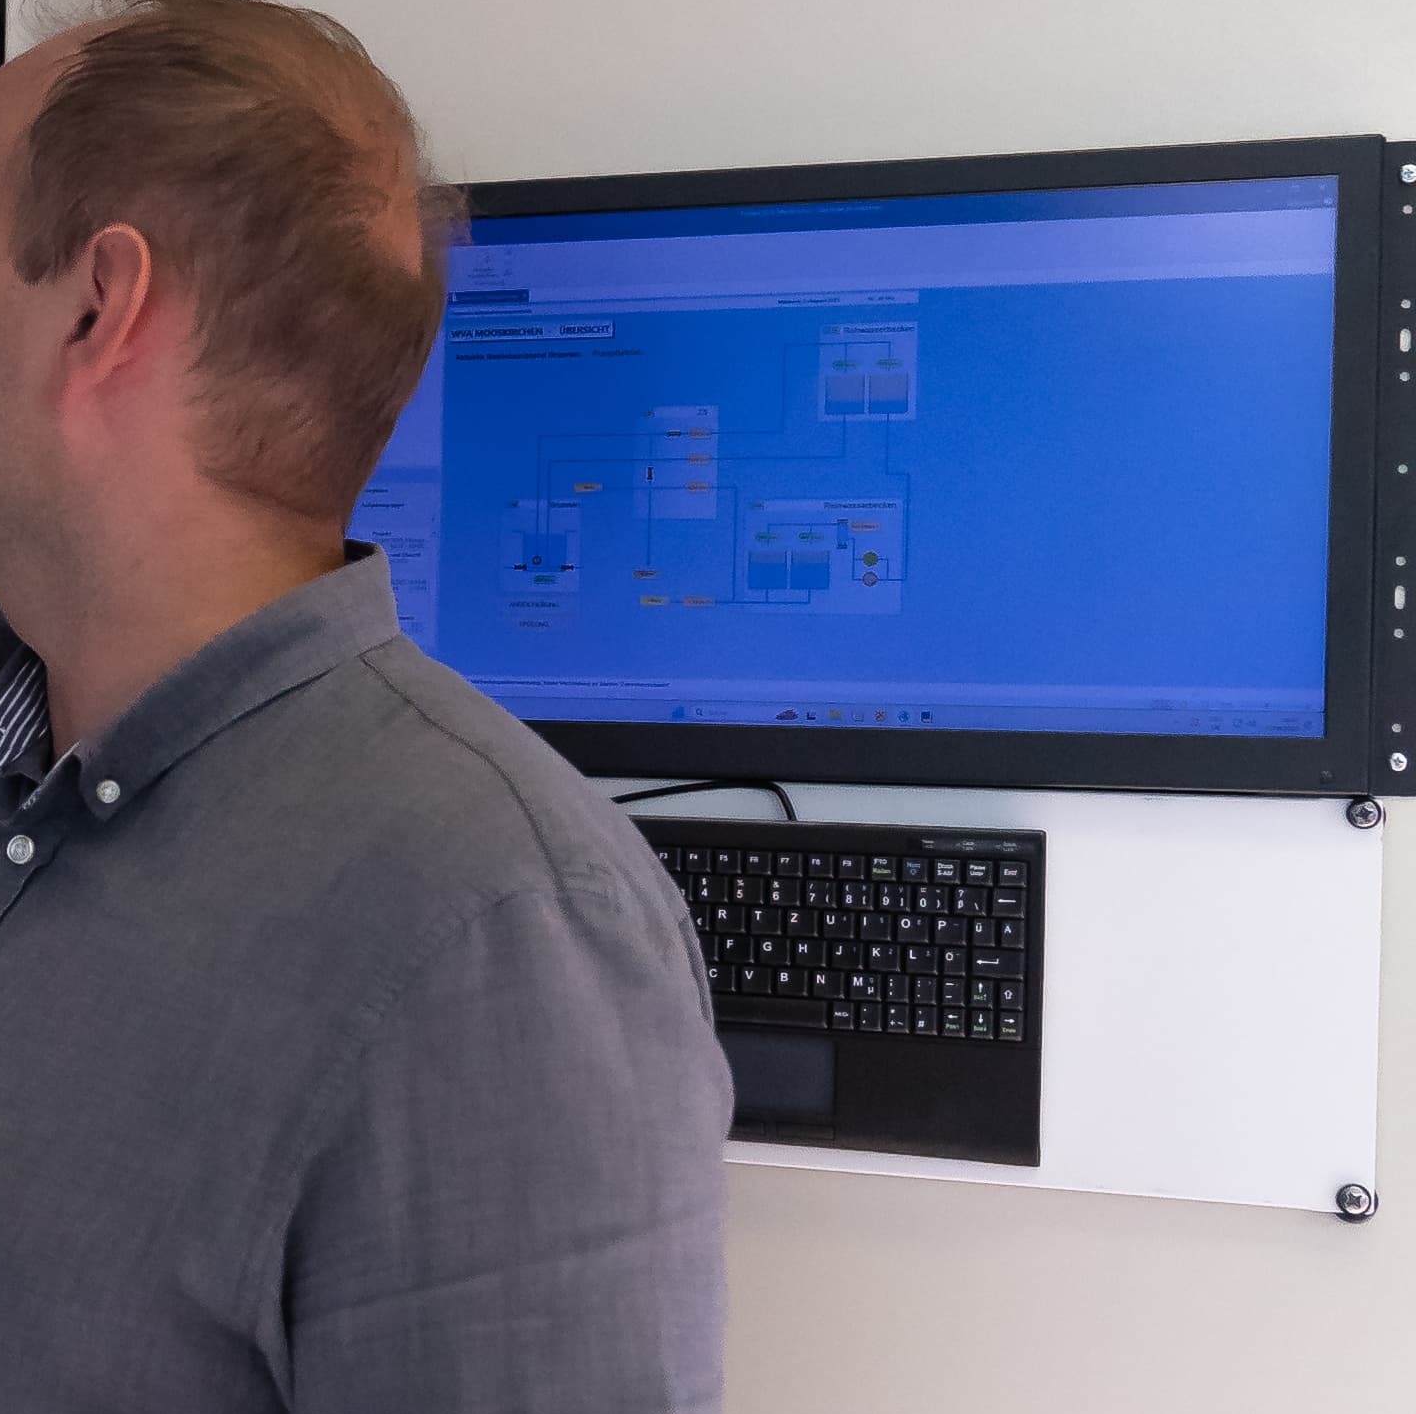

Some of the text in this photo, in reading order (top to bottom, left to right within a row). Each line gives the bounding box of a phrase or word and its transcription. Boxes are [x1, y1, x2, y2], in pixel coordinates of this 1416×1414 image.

[475, 328, 543, 337] MOOSKIRCHEN
[559, 324, 610, 335] ÜBERSICHT
[701, 889, 708, 897] 4
[736, 890, 744, 899] 5
[772, 891, 780, 901] 6
[809, 892, 816, 903] 7
[958, 889, 965, 898] ?
[845, 895, 853, 904] 8
[882, 896, 890, 906] 9
[919, 898, 927, 907] 0
[718, 909, 727, 919] R
[754, 910, 763, 921] T
[790, 913, 799, 923] Z
[826, 915, 835, 925] U
[900, 919, 911, 929] O
[938, 920, 947, 930] P
[975, 923, 983, 933] Ü
[726, 939, 734, 949] F
[762, 941, 772, 952] G
[798, 943, 807, 953] H
[835, 945, 843, 956] J
[872, 947, 881, 957] K
[909, 949, 917, 960] L
[709, 968, 718, 978] C
[745, 970, 754, 980] V
[780, 972, 789, 982] B
[816, 974, 825, 984] N
[853, 977, 863, 986] M
[917, 1020, 925, 1028] #
